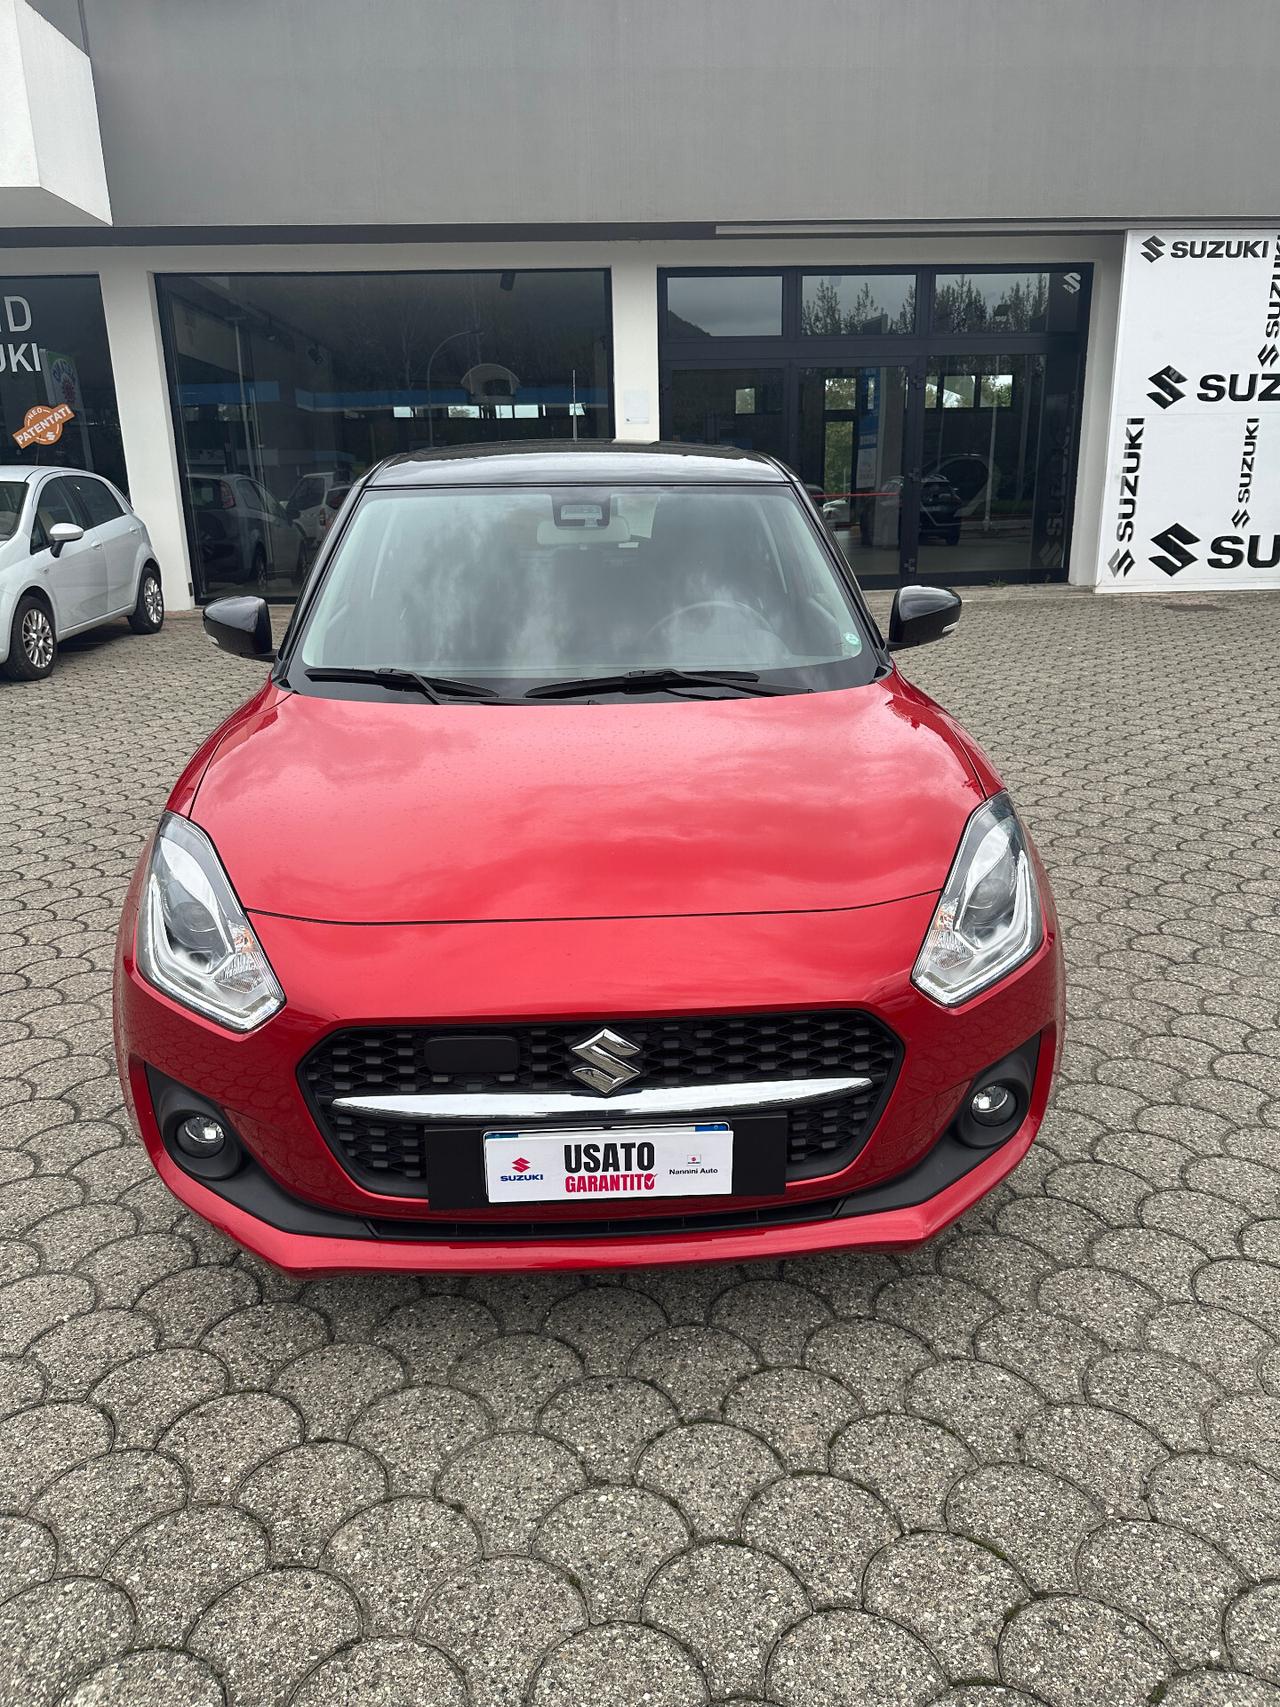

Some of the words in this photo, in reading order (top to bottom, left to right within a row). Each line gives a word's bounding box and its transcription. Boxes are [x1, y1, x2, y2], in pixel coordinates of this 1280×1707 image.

[1170, 240, 1270, 259] SUZUKI
[0, 296, 32, 332] D
[1196, 373, 1280, 402] SUZ
[16, 404, 72, 444] PATENTATI
[27, 407, 43, 420] NEO
[1237, 418, 1260, 504] SUZUKI
[1116, 417, 1145, 543] SUZUKI
[1206, 534, 1280, 570] SU
[563, 1142, 655, 1174] USATO
[500, 1174, 544, 1182] SUZUKI
[565, 1173, 657, 1193] GARANTITO
